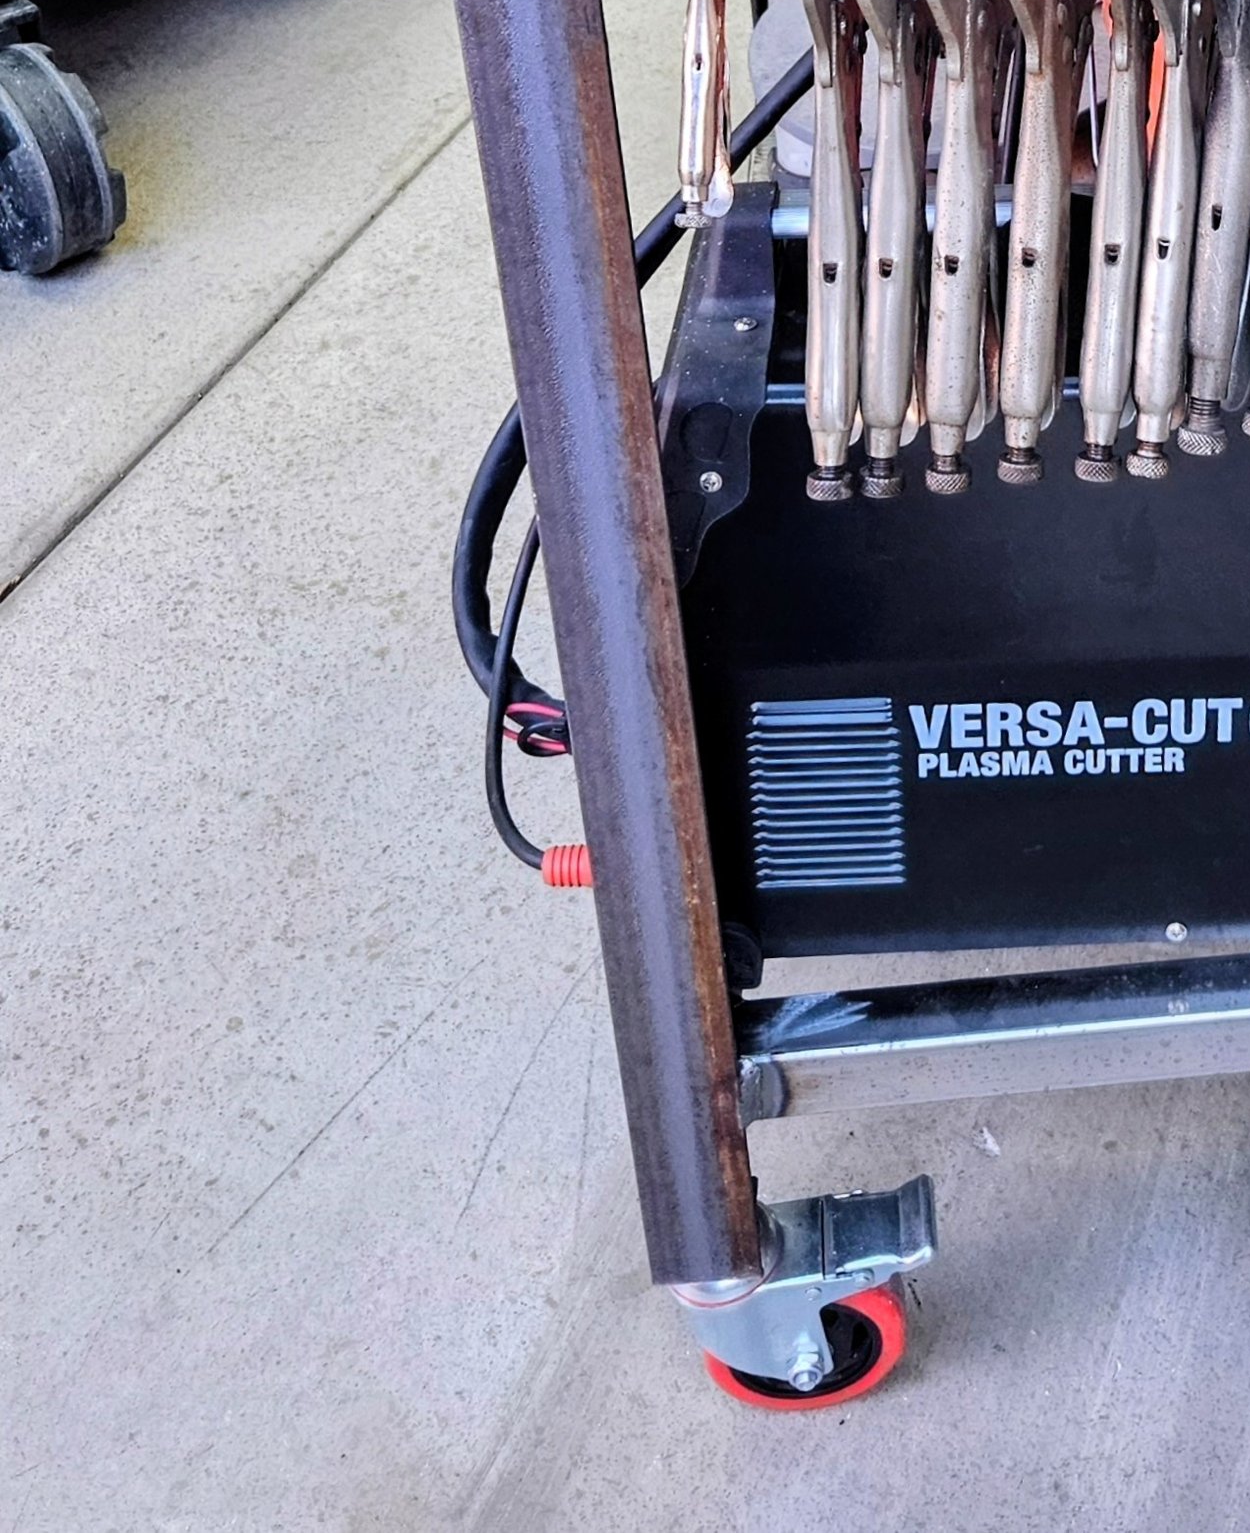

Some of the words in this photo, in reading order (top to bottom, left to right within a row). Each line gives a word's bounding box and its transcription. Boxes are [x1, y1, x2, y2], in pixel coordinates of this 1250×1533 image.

[908, 697, 1244, 749] VERSA-CUT
[918, 750, 1053, 778] PLASMA
[1064, 747, 1185, 775] CUTTER
